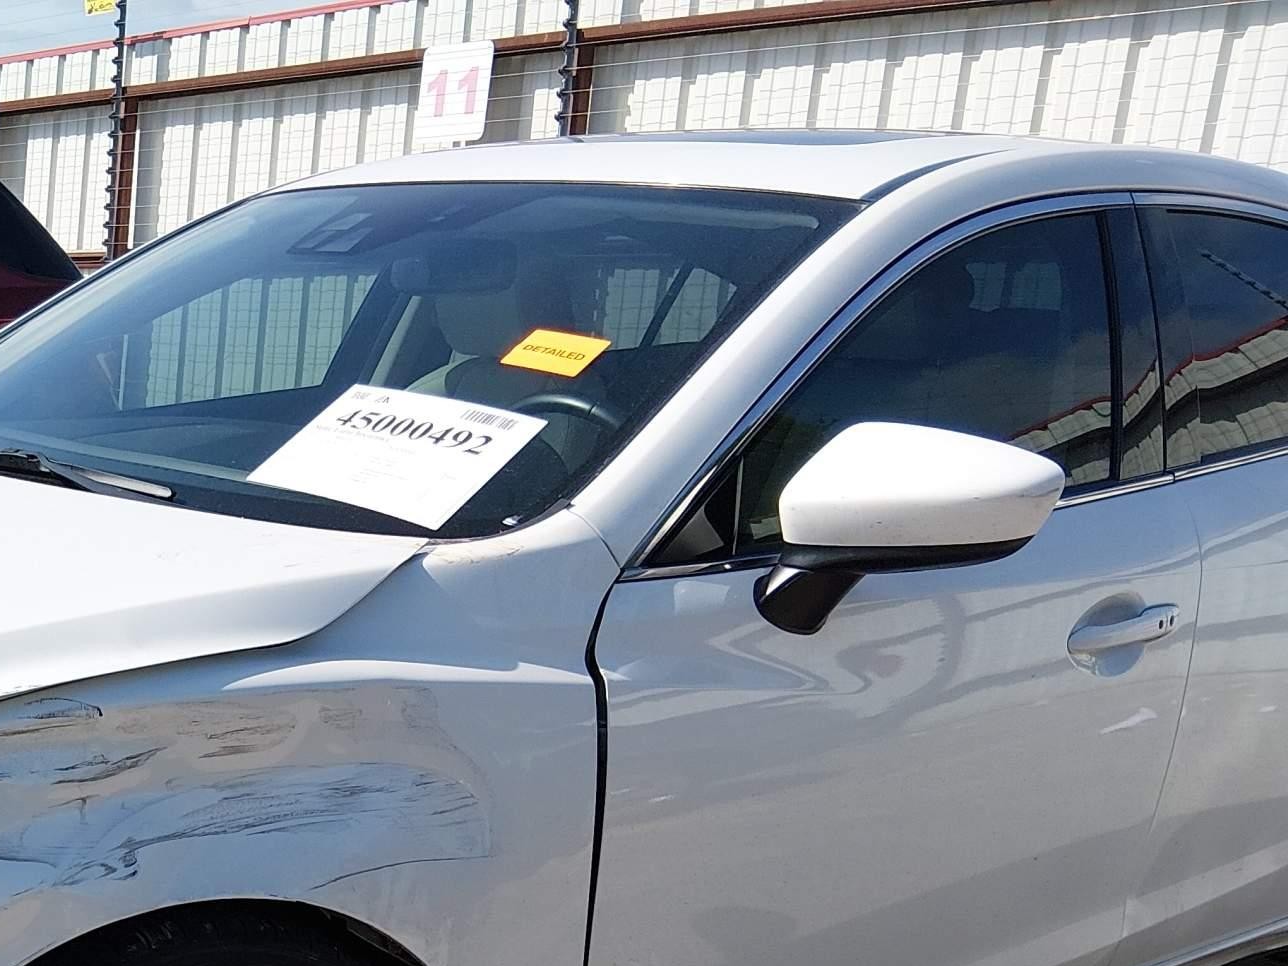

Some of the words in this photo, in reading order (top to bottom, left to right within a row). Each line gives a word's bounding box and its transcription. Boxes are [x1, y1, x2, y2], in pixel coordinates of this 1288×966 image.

[427, 66, 479, 117] 11
[522, 344, 586, 361] DETAILED
[336, 409, 493, 455] 45000492
